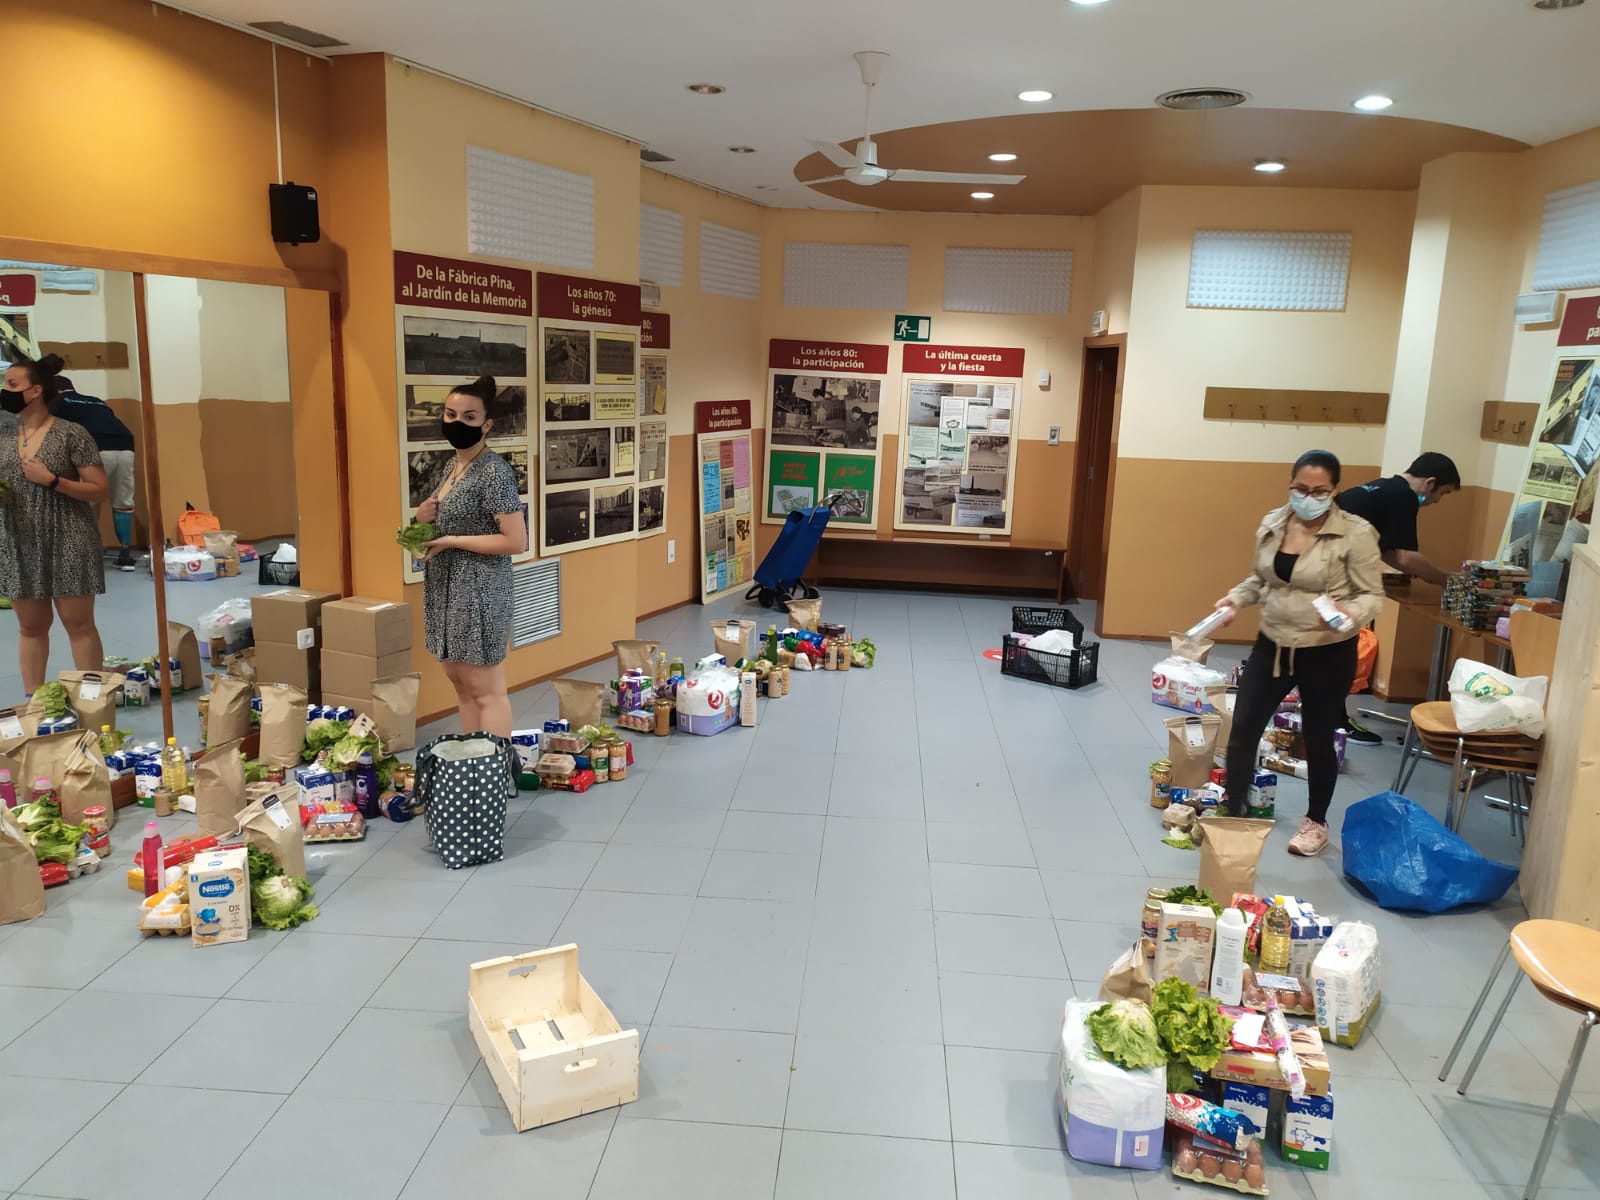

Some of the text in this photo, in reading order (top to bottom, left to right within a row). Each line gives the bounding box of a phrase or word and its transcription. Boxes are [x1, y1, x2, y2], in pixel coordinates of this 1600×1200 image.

[416, 264, 515, 292] De la Fábrica Pina,
[402, 282, 527, 309] al Jardín de la Memoria
[567, 284, 617, 302] Los años 70:
[572, 301, 612, 318] la génesis
[800, 346, 858, 358] Los años 80:
[925, 350, 1002, 362] La última cuesta
[792, 356, 865, 369] la participación
[940, 362, 985, 372] y la fiesta
[712, 407, 720, 416] Los
[720, 406, 731, 415] años
[709, 417, 742, 429] la participación
